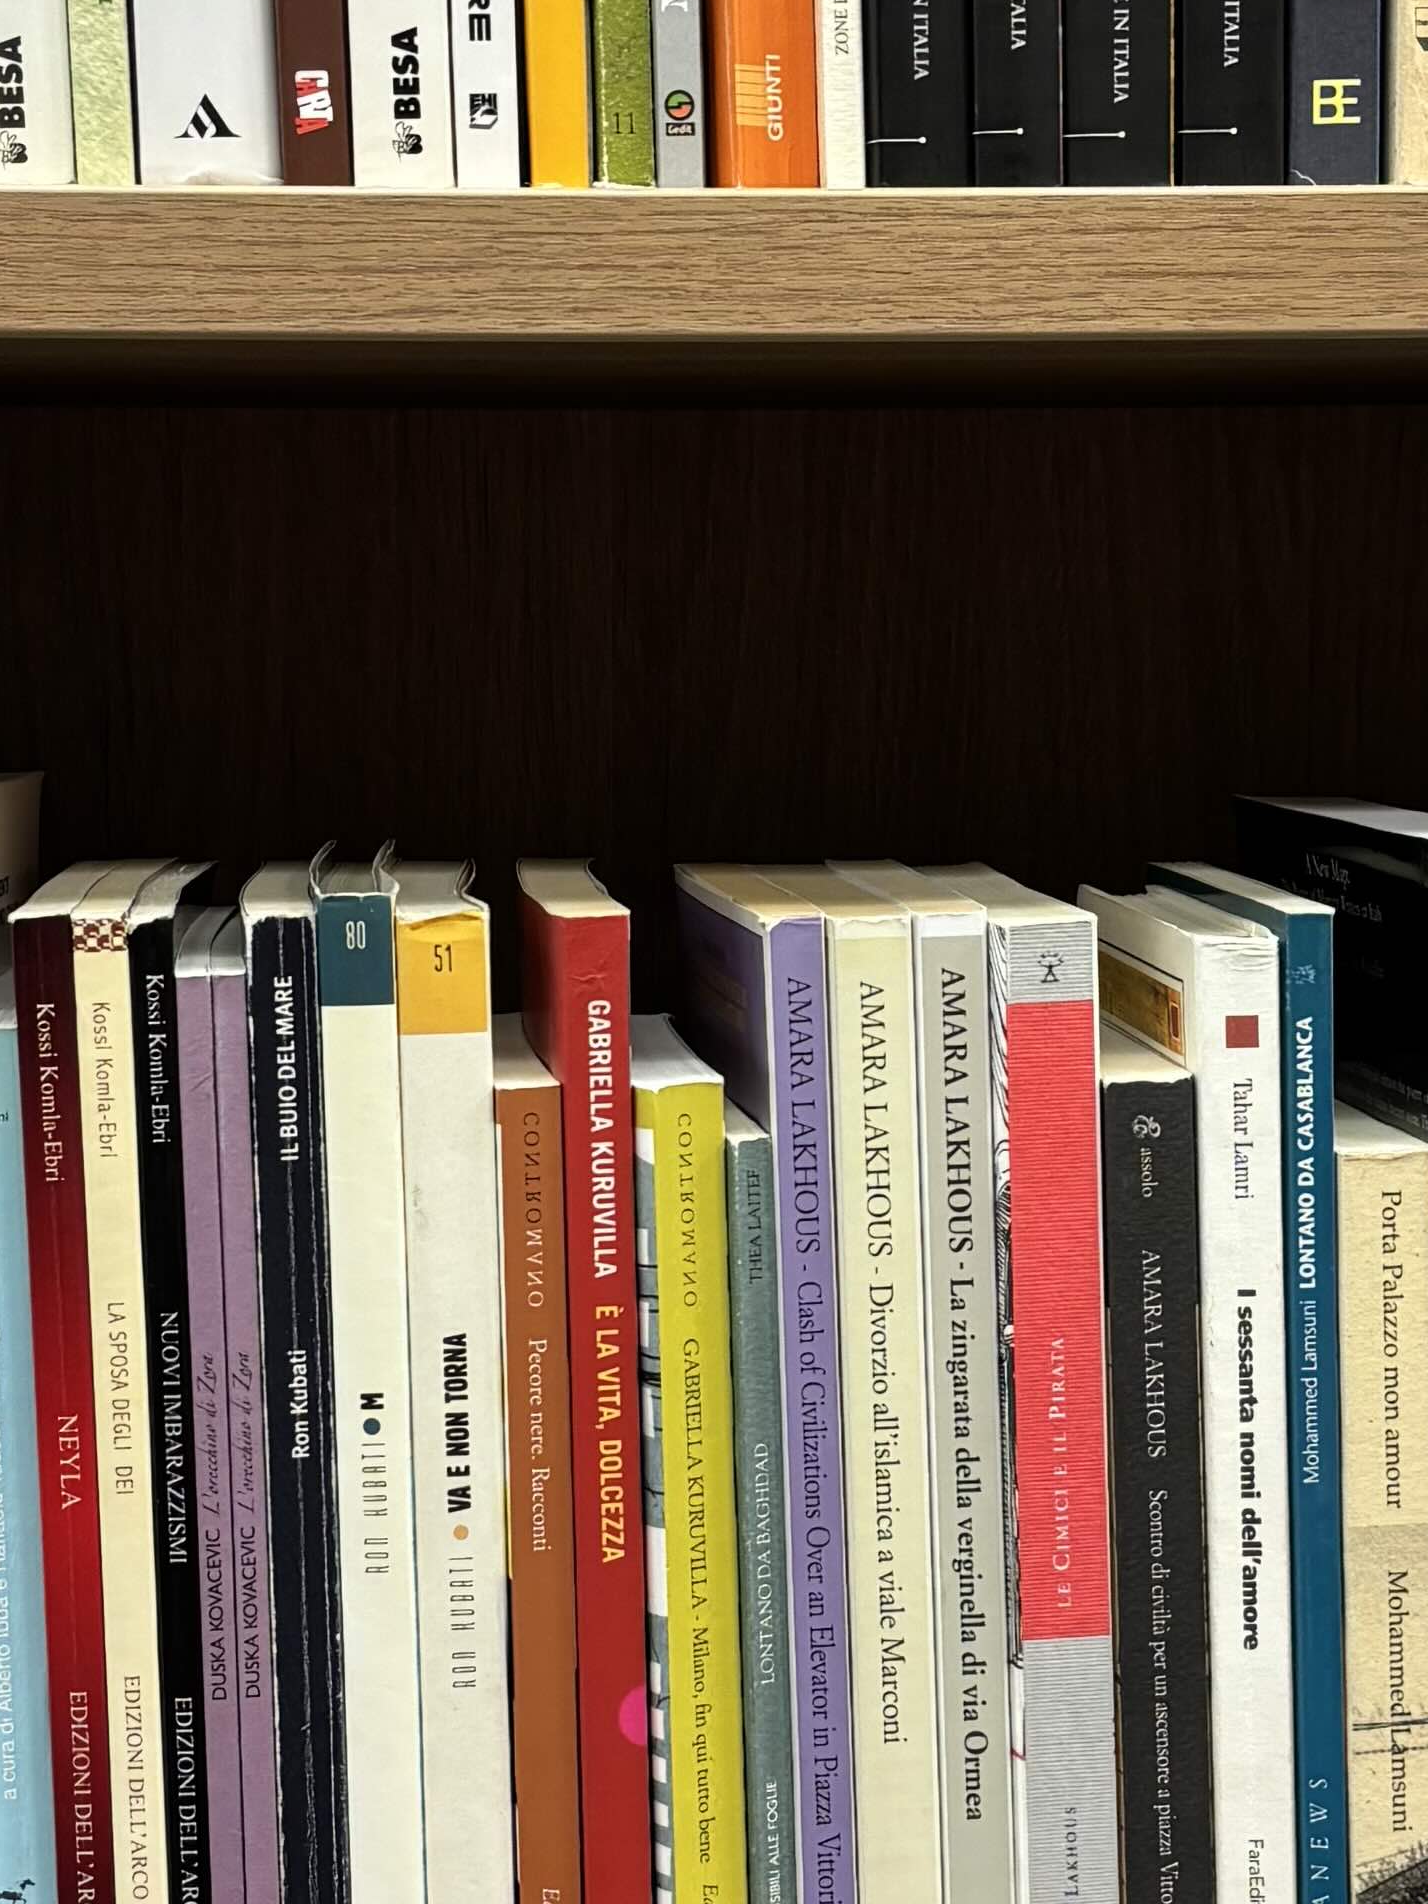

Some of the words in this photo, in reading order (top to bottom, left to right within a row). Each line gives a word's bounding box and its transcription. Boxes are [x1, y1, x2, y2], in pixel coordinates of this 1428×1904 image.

[588, 1000, 613, 1132] GABRIELLA
[1233, 1078, 1253, 1135] Tahar
[1234, 1142, 1254, 1199] Lamri
[591, 1142, 617, 1278] KURUVILLA
[1382, 1190, 1402, 1254] Porta
[596, 1306, 624, 1319] È
[1237, 1289, 1256, 1297] I
[1382, 1264, 1404, 1358] Palazzo
[160, 1312, 180, 1386] NUOVI
[596, 1329, 620, 1359] LA
[1237, 1306, 1258, 1422] sessanta
[596, 1367, 621, 1429] VITA,
[1384, 1367, 1399, 1421] mon
[164, 1394, 187, 1563] IMBARAZZISMI
[1240, 1432, 1261, 1498] nomi
[1385, 1429, 1401, 1509] amour
[599, 1440, 625, 1563] DOLCEZZA
